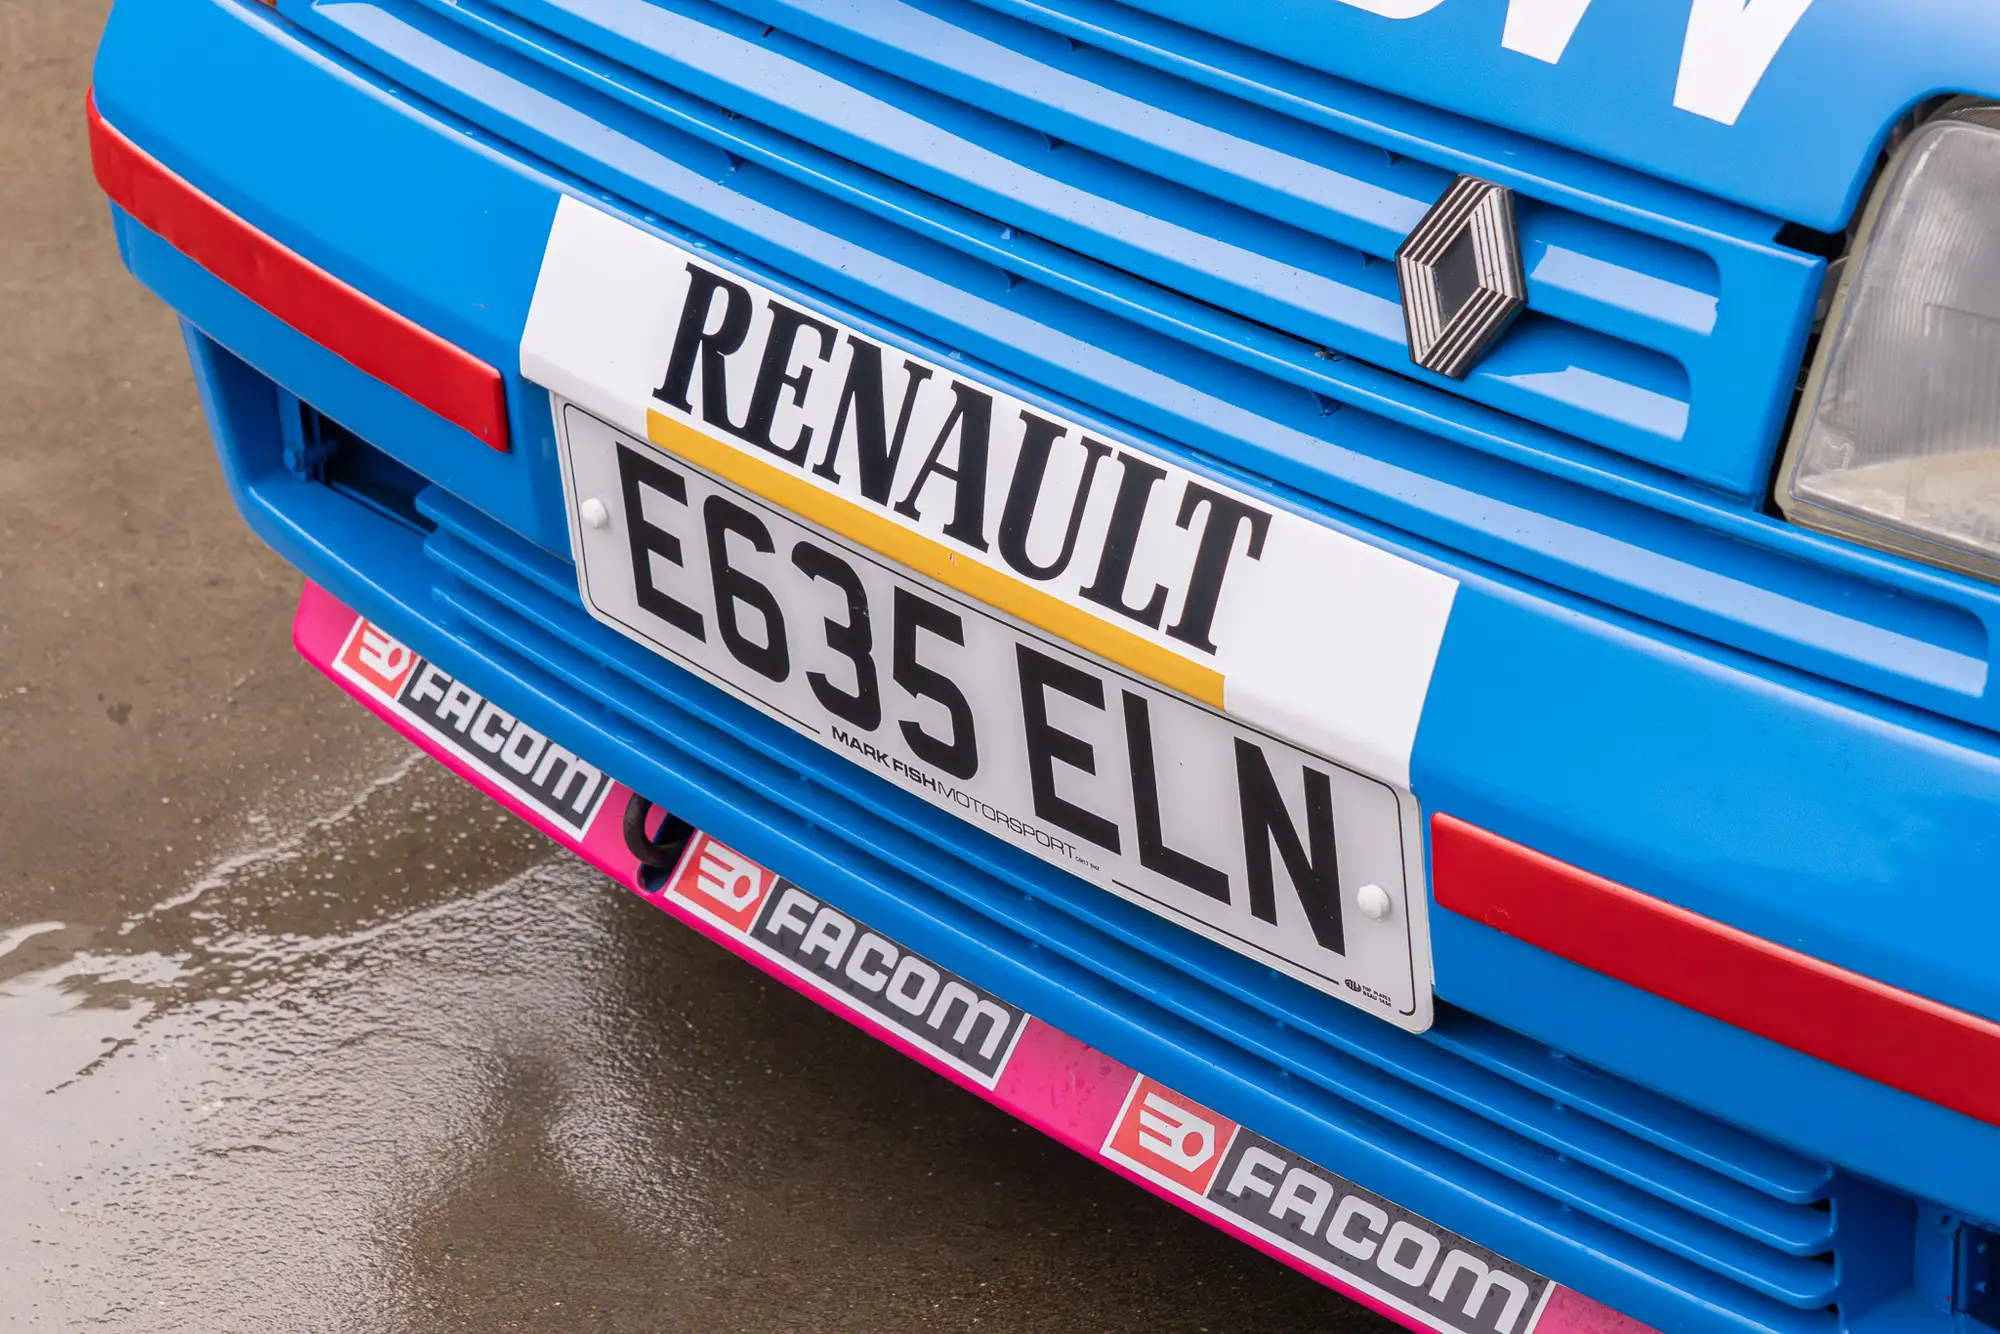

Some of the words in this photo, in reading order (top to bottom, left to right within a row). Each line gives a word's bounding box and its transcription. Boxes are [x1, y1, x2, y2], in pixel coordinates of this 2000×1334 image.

[653, 262, 1272, 656] RENAULT
[410, 661, 602, 814] FACOM
[616, 441, 979, 782] E635
[1016, 641, 1346, 957] ELN
[831, 725, 890, 769] MARK
[765, 887, 1011, 1060] FACOM
[1226, 1146, 1530, 1334] FACOM
